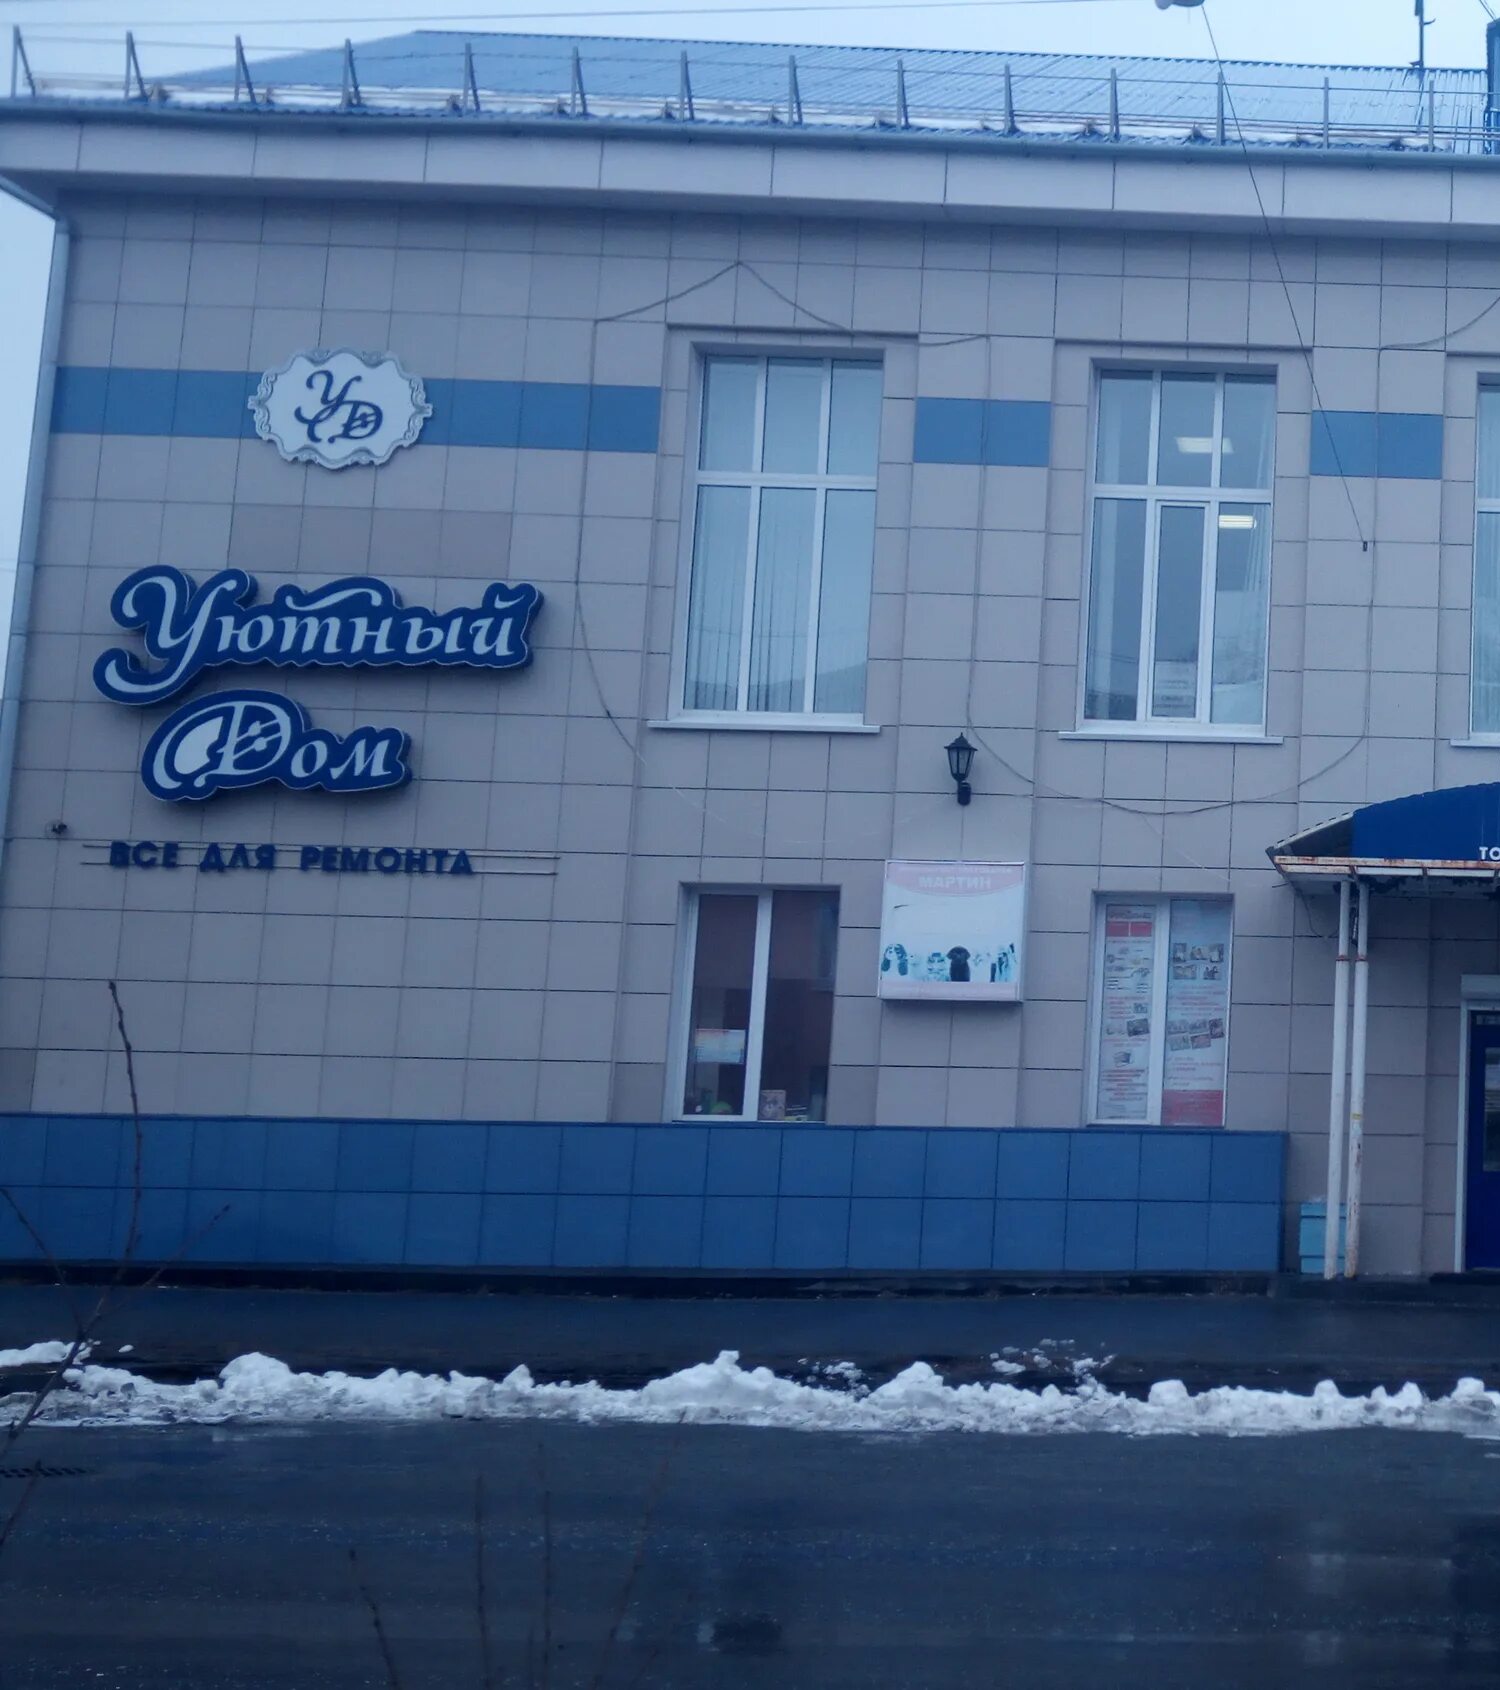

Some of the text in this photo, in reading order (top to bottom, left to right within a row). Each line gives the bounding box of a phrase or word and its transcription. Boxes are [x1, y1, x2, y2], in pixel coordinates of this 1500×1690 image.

[104, 573, 525, 694] Уютный
[152, 700, 392, 791] Дом
[109, 840, 474, 875] ВСЕ ДЛЯ РЕМОНТА
[918, 876, 992, 890] МАРТИН
